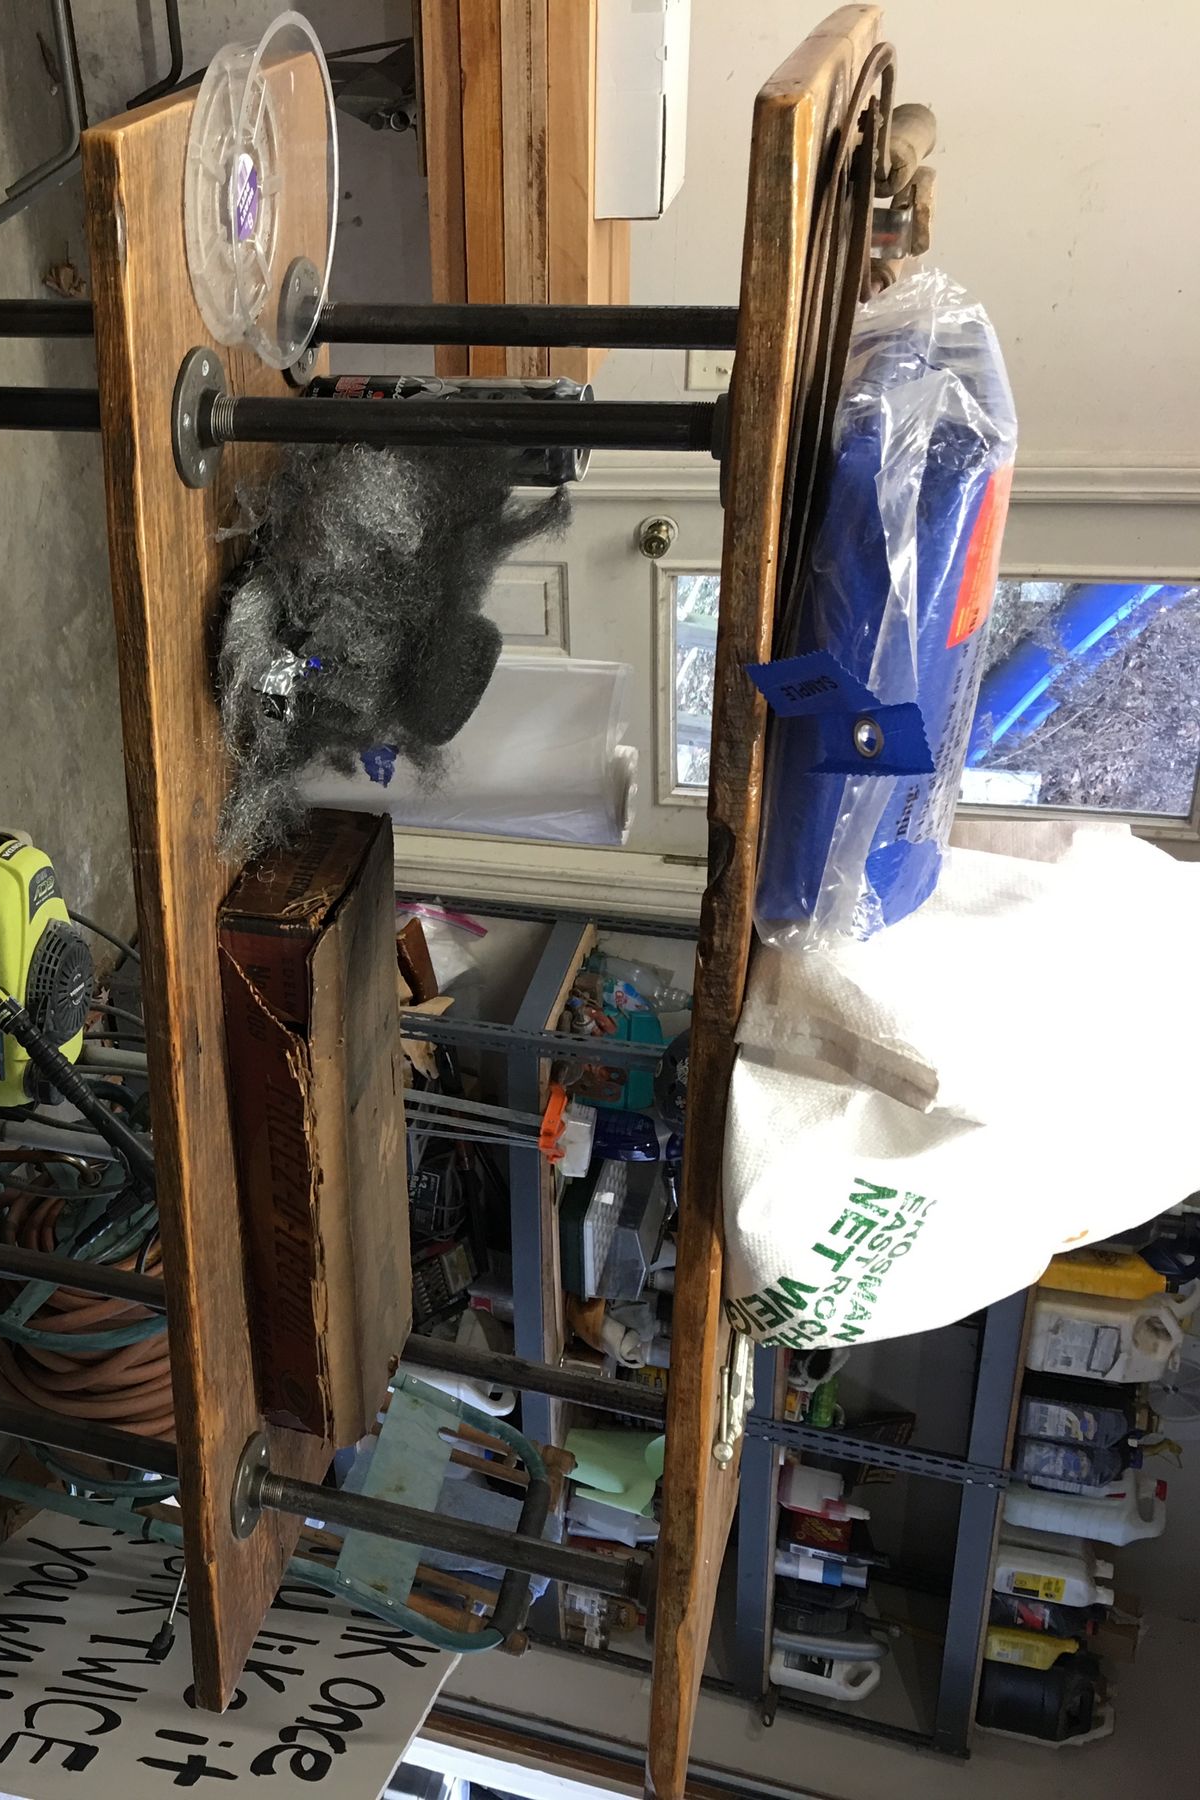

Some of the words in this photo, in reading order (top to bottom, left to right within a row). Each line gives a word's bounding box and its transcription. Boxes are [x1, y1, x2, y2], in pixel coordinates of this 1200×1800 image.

[781, 676, 838, 702] SAMPLE
[811, 1177, 898, 1273] NET
[855, 1192, 926, 1269] EAST
[3, 1537, 112, 1603] you
[137, 1729, 239, 1787] it
[250, 1677, 386, 1783] once
